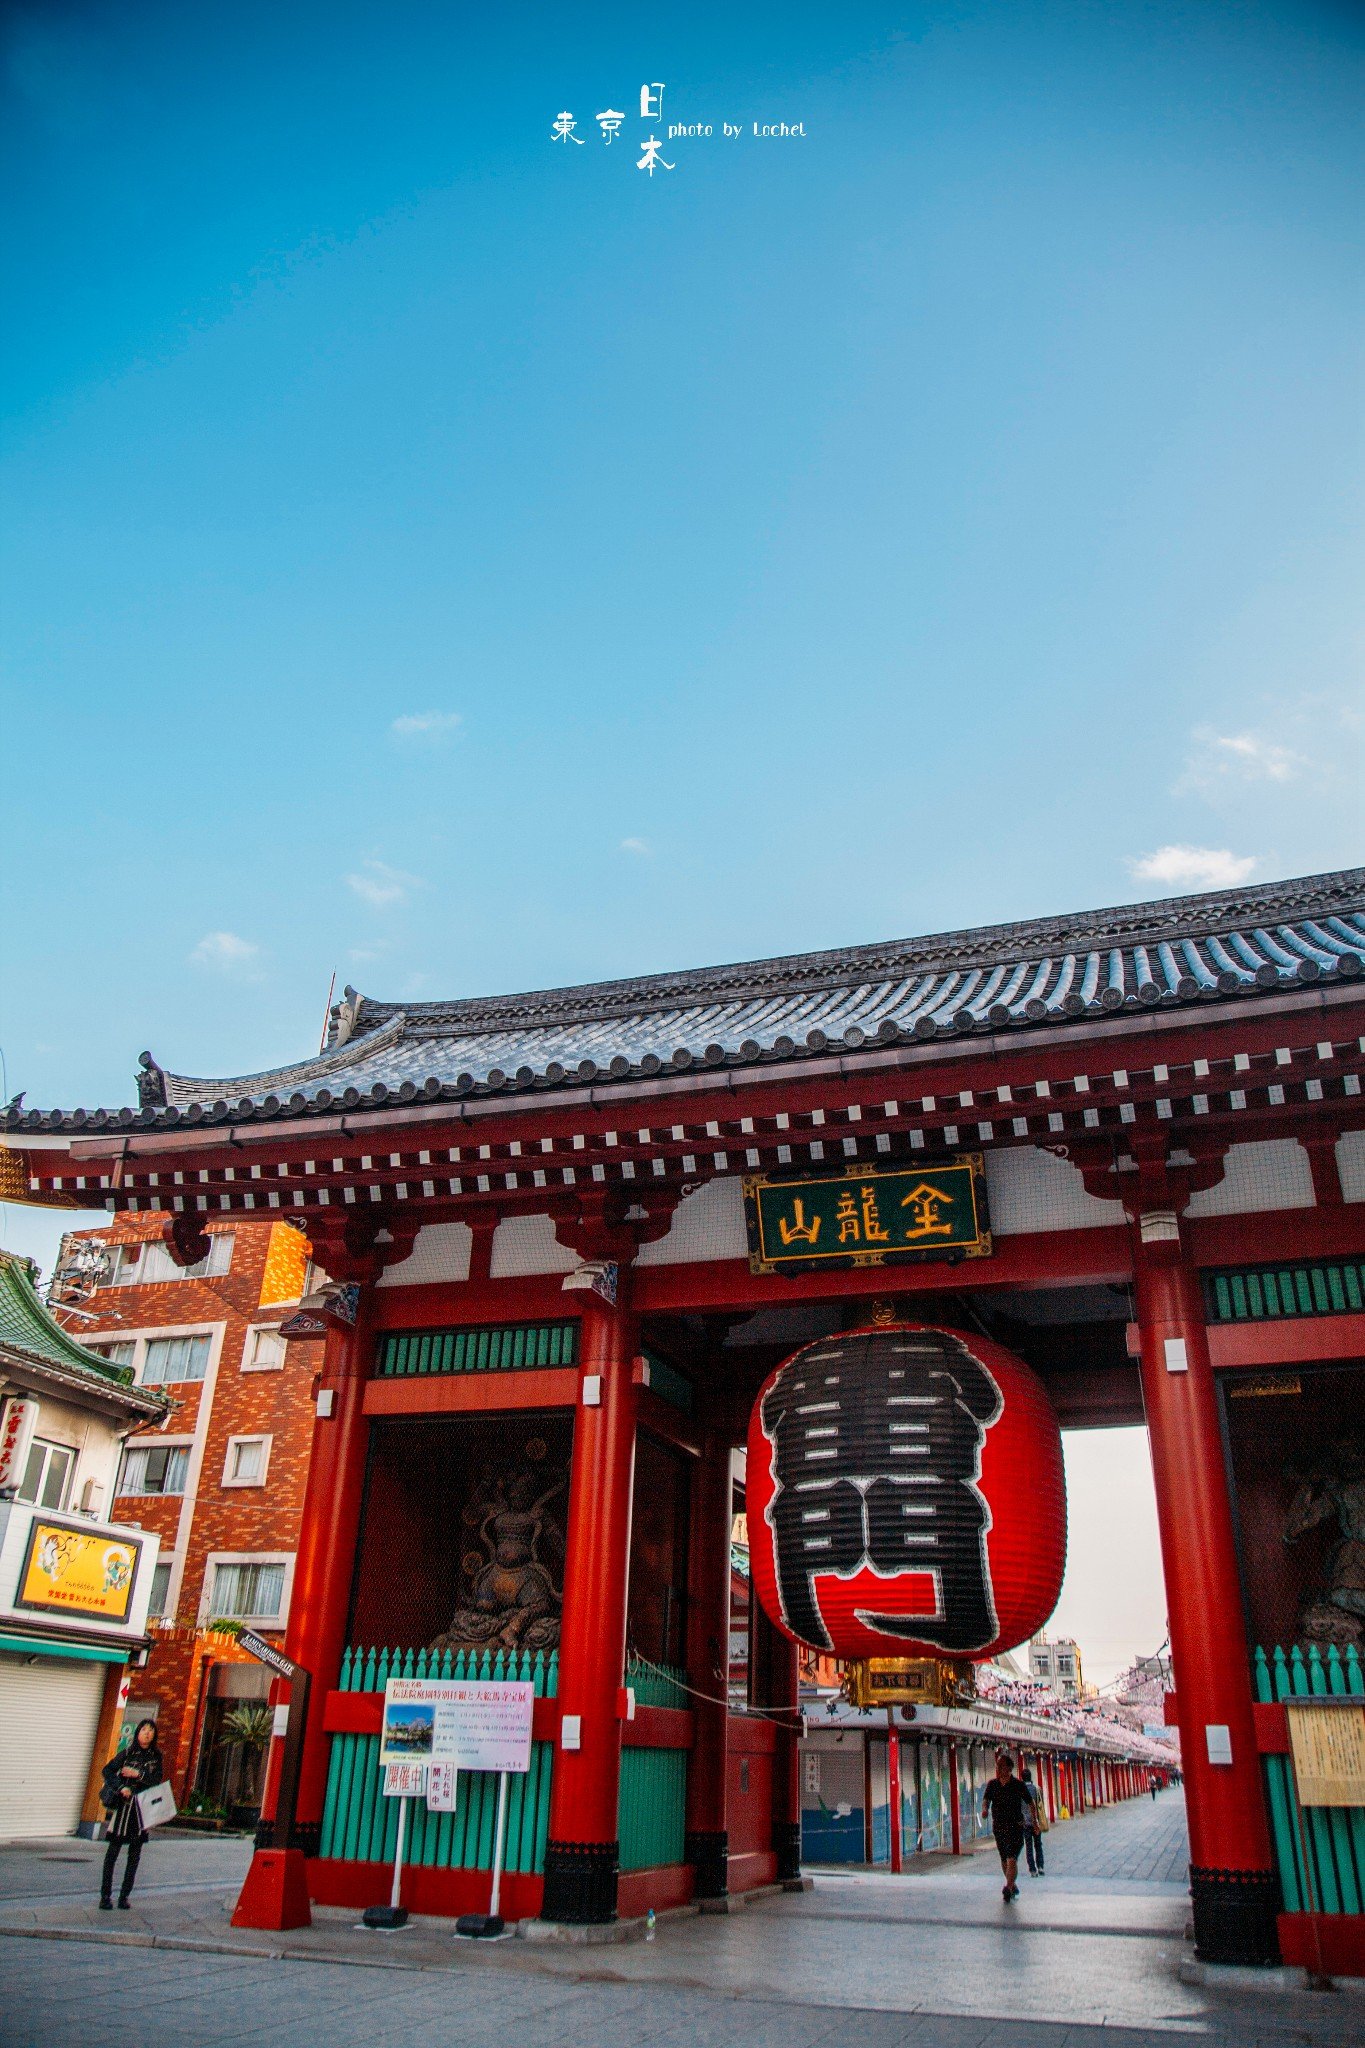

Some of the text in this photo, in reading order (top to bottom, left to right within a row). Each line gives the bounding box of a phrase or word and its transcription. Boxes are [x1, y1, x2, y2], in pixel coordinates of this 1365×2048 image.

[759, 1327, 1005, 1652] 雷門
[244, 1633, 281, 1662] KAMINARIMON
[279, 1659, 295, 1673] GATE
